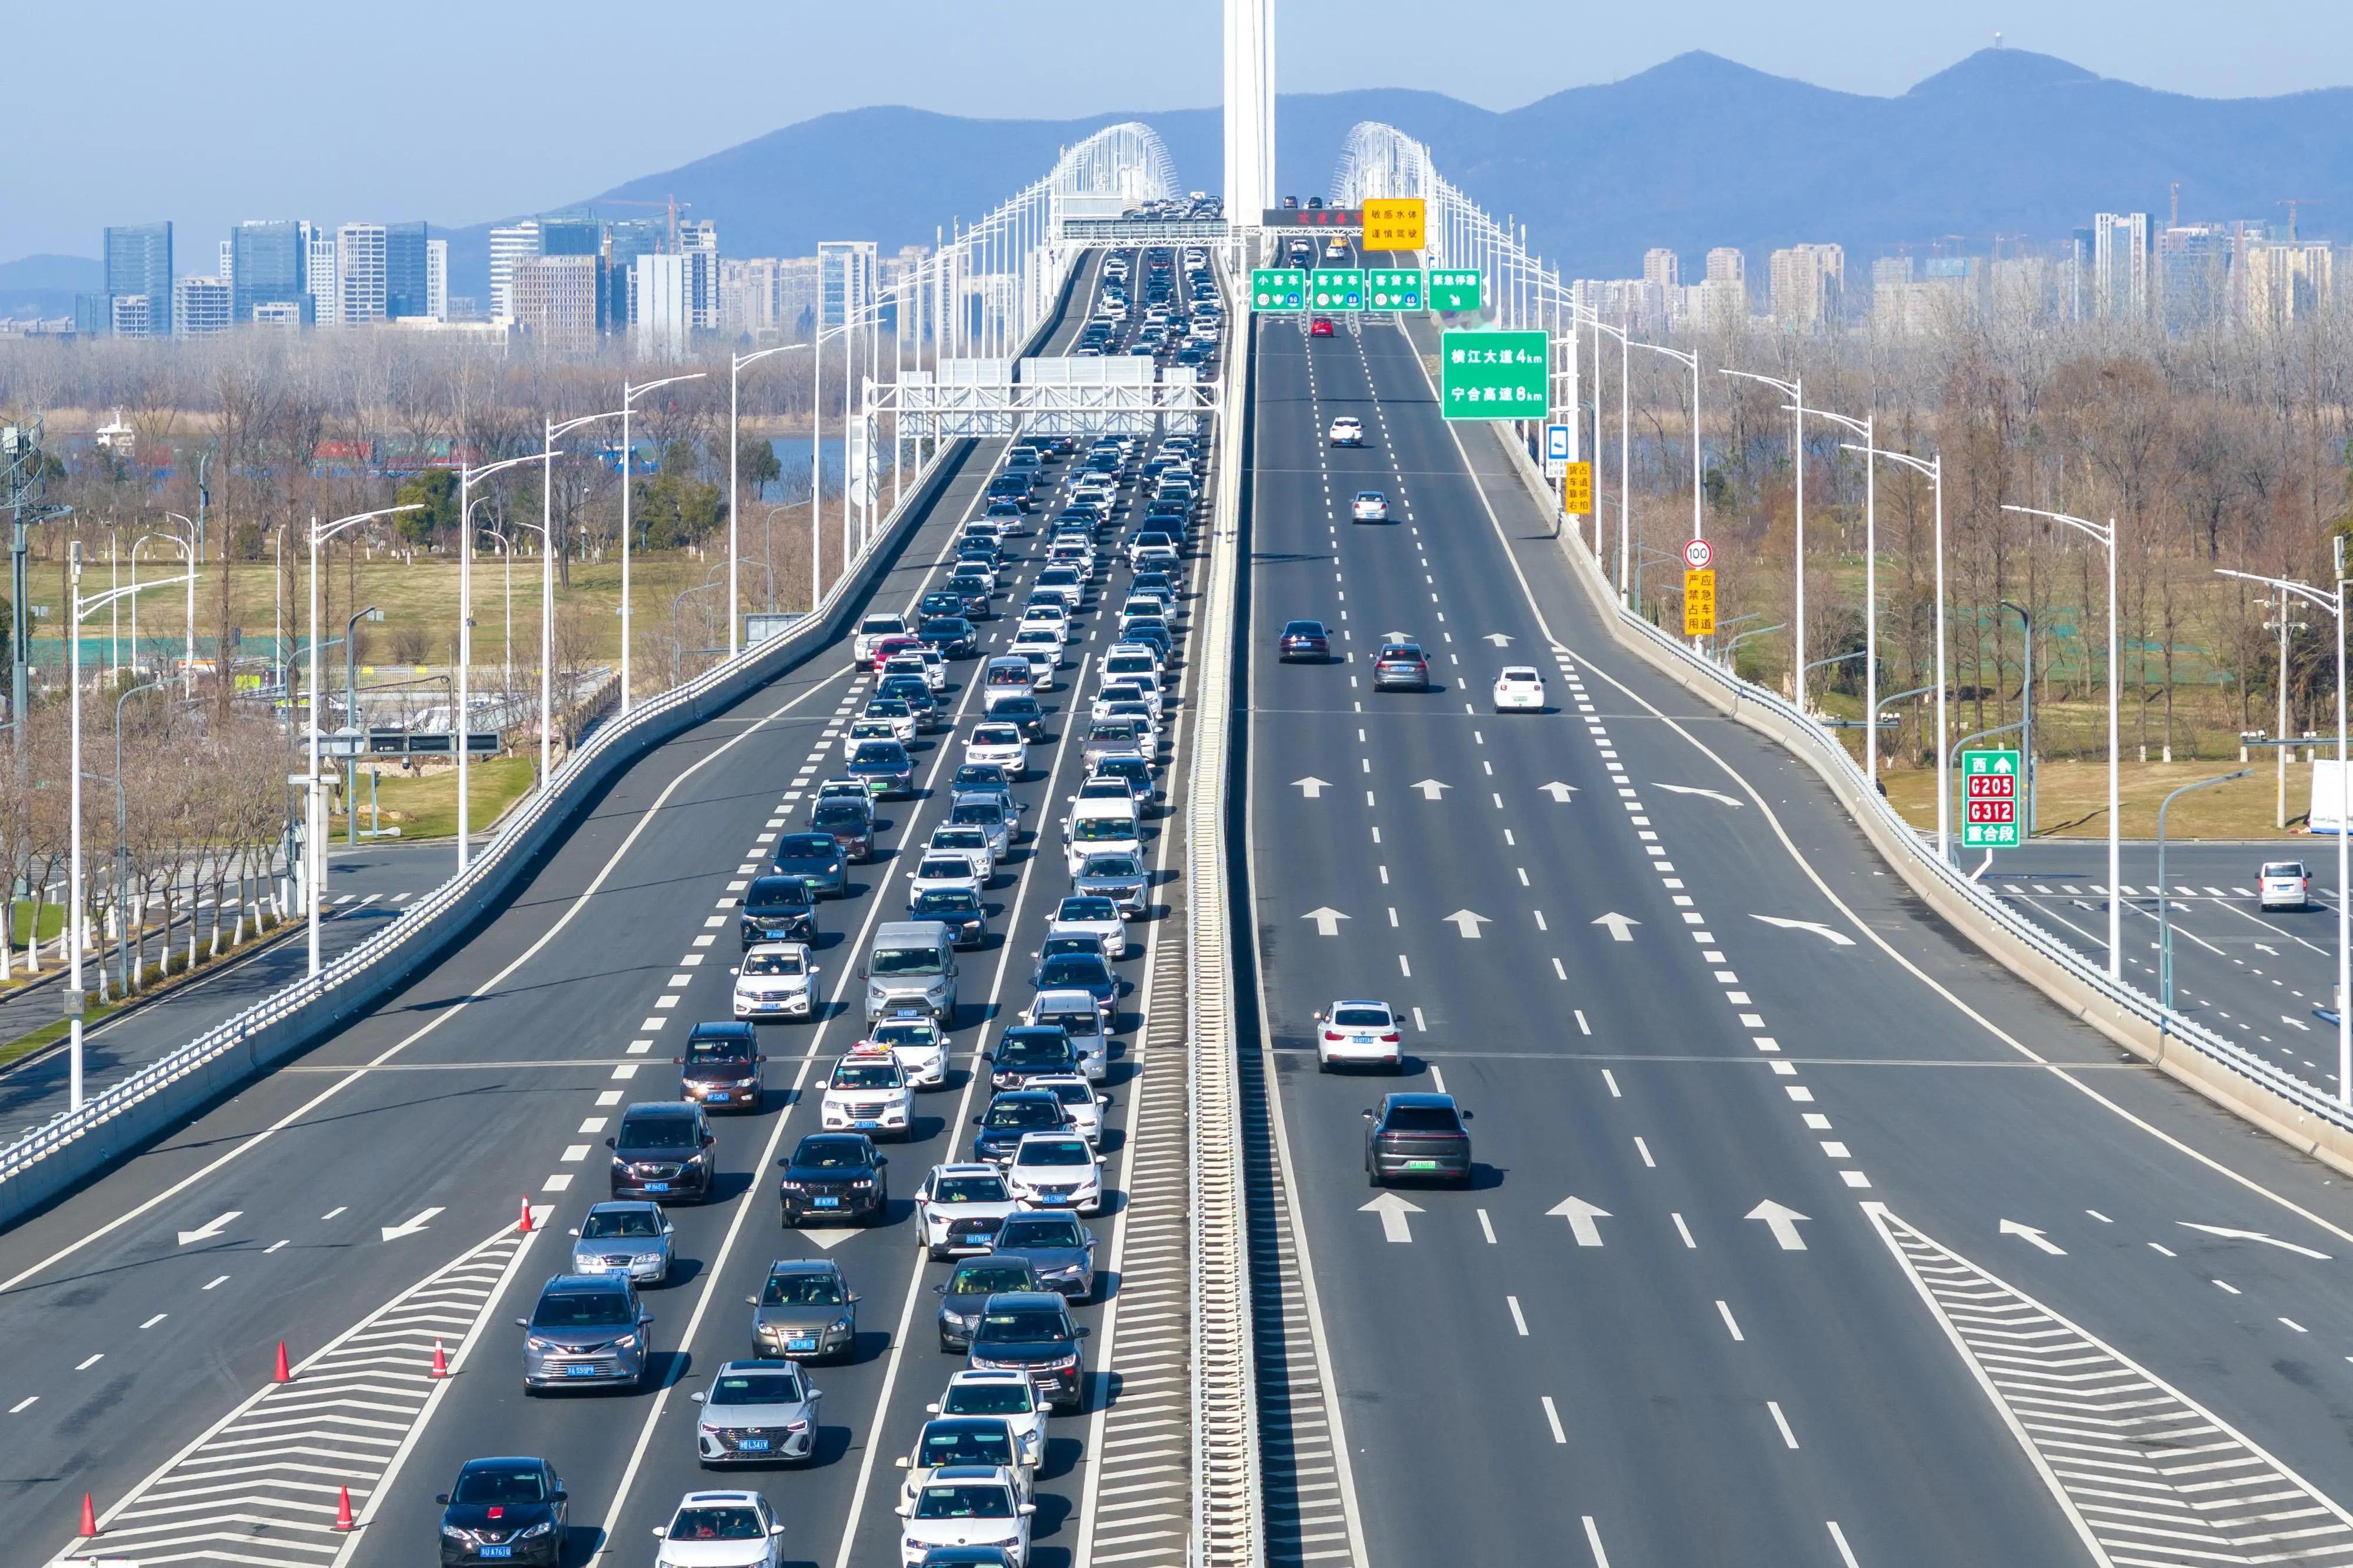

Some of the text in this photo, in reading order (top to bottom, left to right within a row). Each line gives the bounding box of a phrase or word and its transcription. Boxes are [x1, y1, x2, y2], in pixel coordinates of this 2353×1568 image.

[1371, 209, 1417, 219] 敏感水体
[1372, 229, 1417, 238] 谨慎驾驶
[1689, 548, 1707, 559] 100
[1688, 575, 1699, 629] 严禁占用
[1701, 575, 1712, 629] 应急车道
[1972, 758, 1987, 773] 西
[1971, 778, 2011, 794] G205
[1971, 803, 2011, 819] G312
[1967, 825, 2015, 842] 重合段
